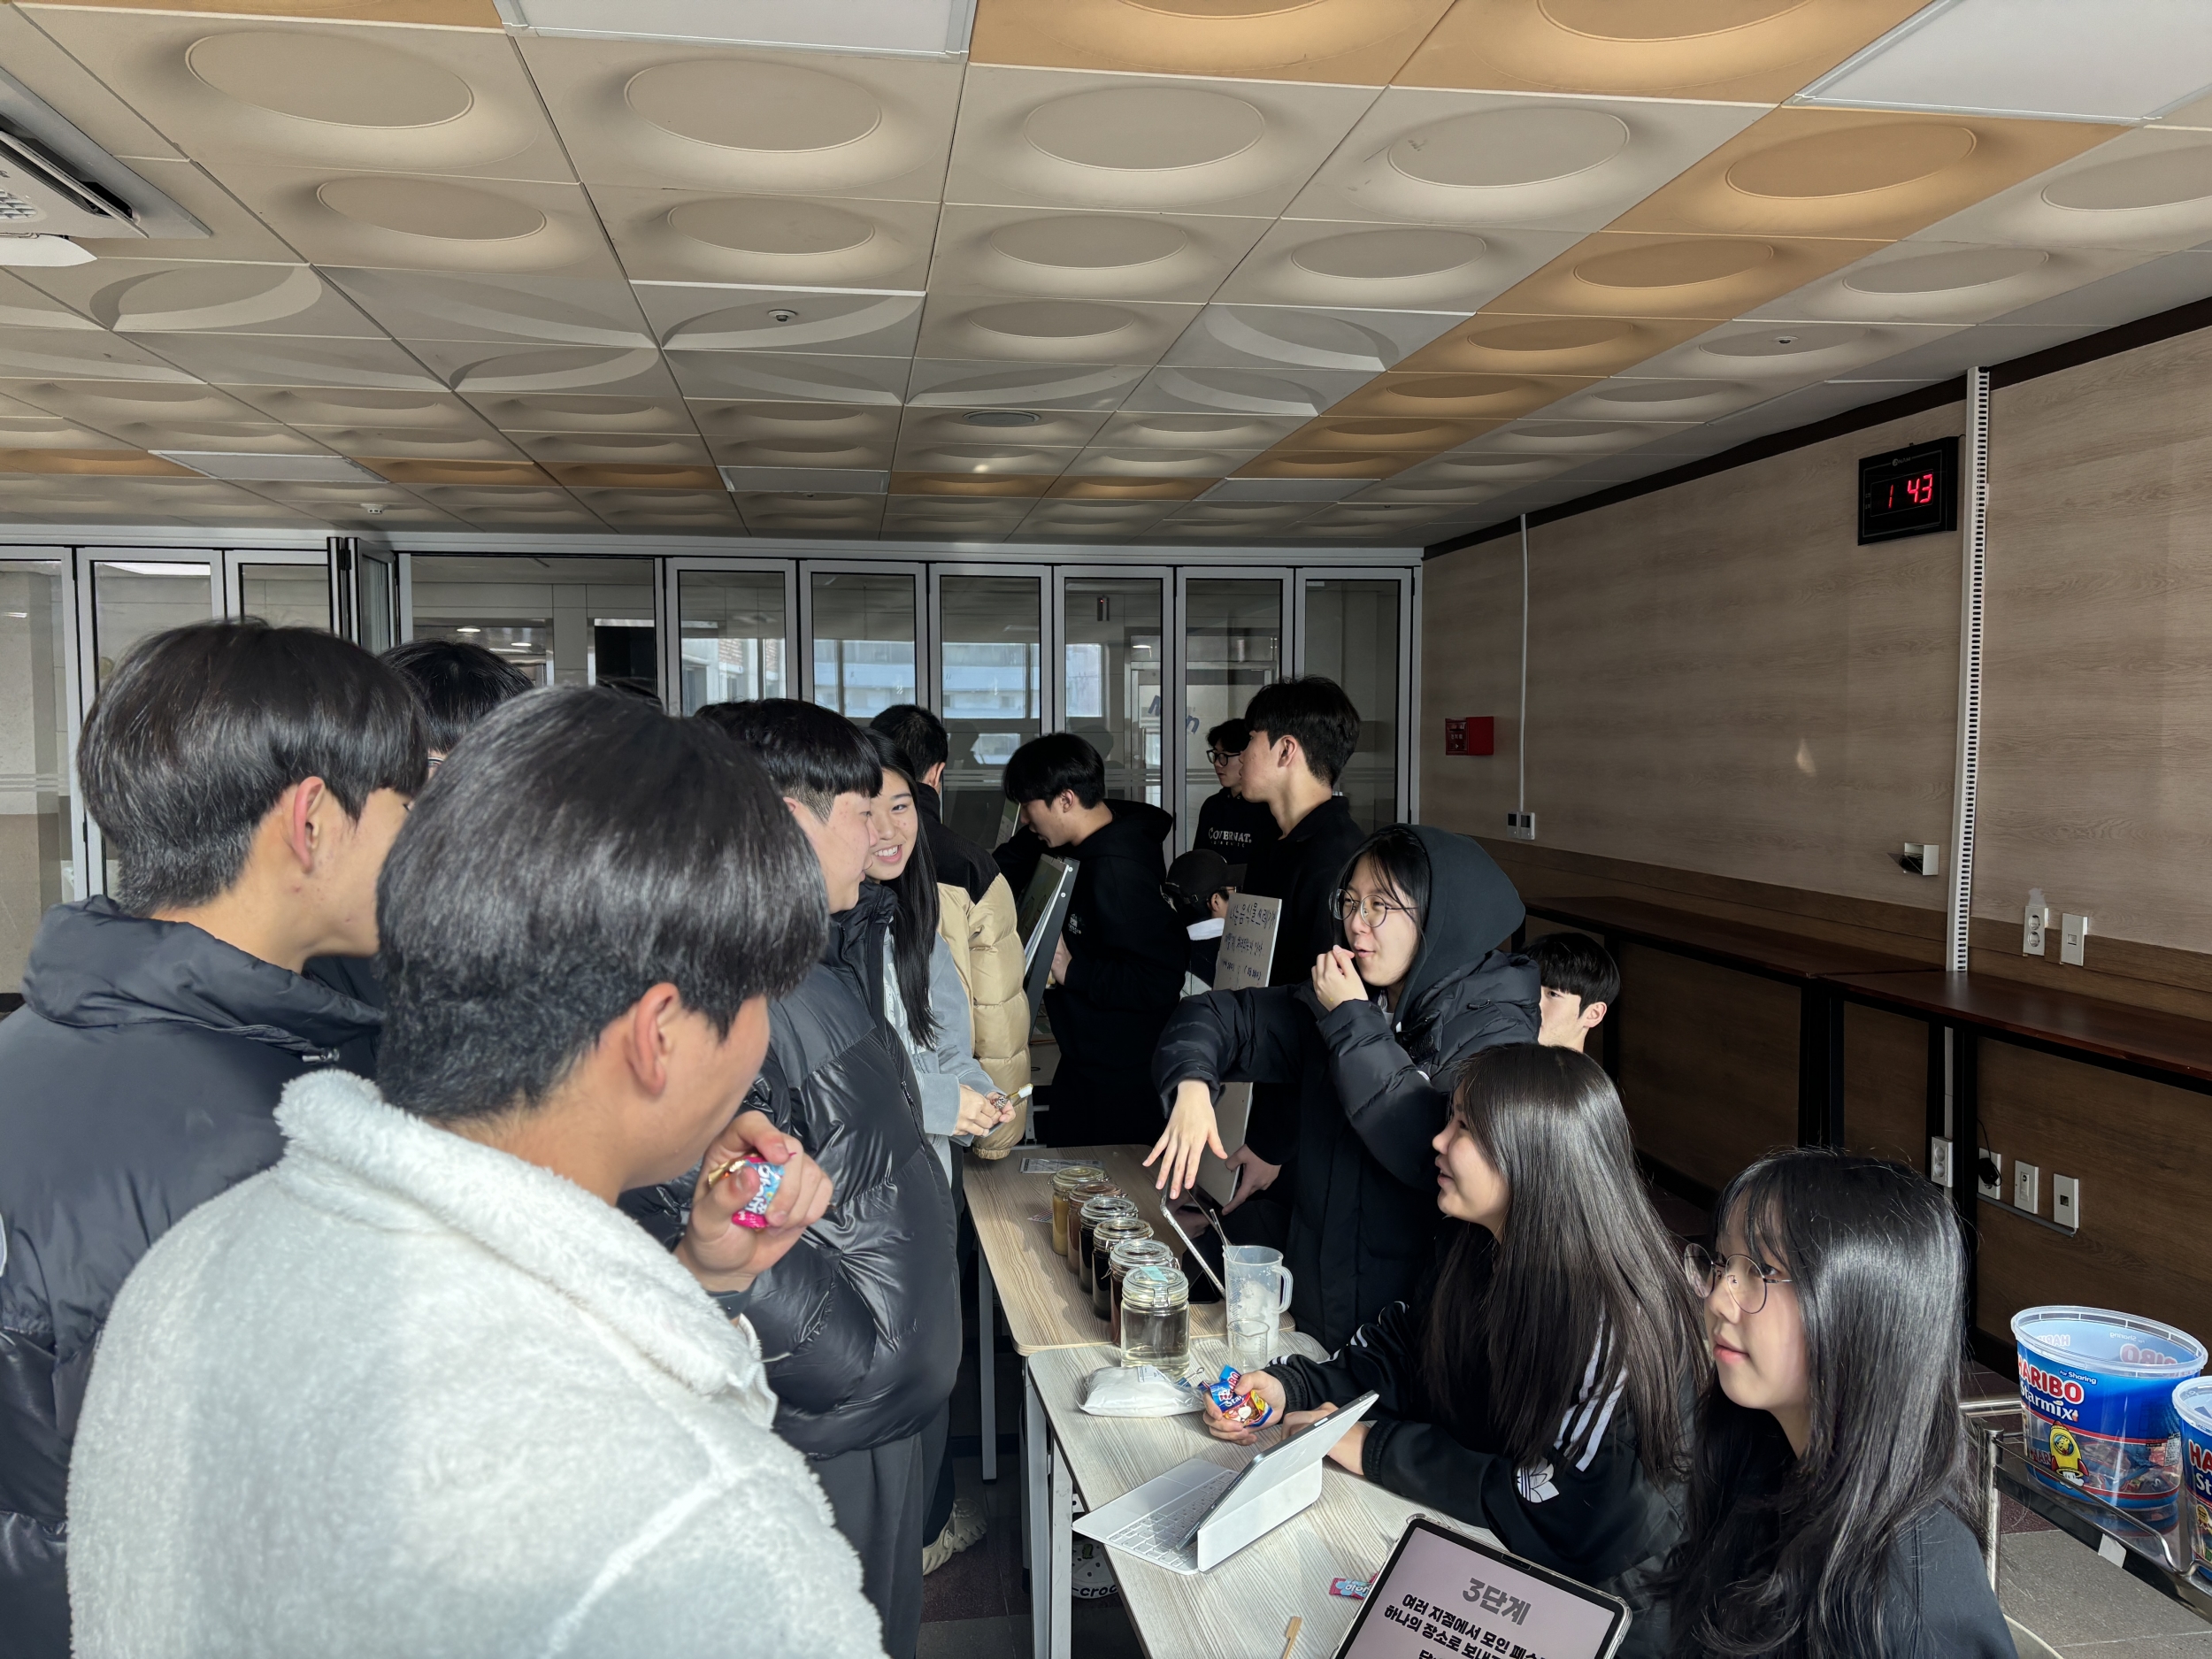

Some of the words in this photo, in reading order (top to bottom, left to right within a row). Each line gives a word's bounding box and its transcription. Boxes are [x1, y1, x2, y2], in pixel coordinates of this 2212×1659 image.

[2020, 1380, 2074, 1422] Starmix
[2068, 1371, 2097, 1385] Sharing
[1402, 1594, 1430, 1616] 여러
[1428, 1606, 1482, 1640] 지점에서
[1480, 1631, 1510, 1655] 모인
[1462, 1578, 1532, 1625] 3단계
[1384, 1604, 1423, 1632] 하나의
[1422, 1623, 1463, 1652] 장소로
